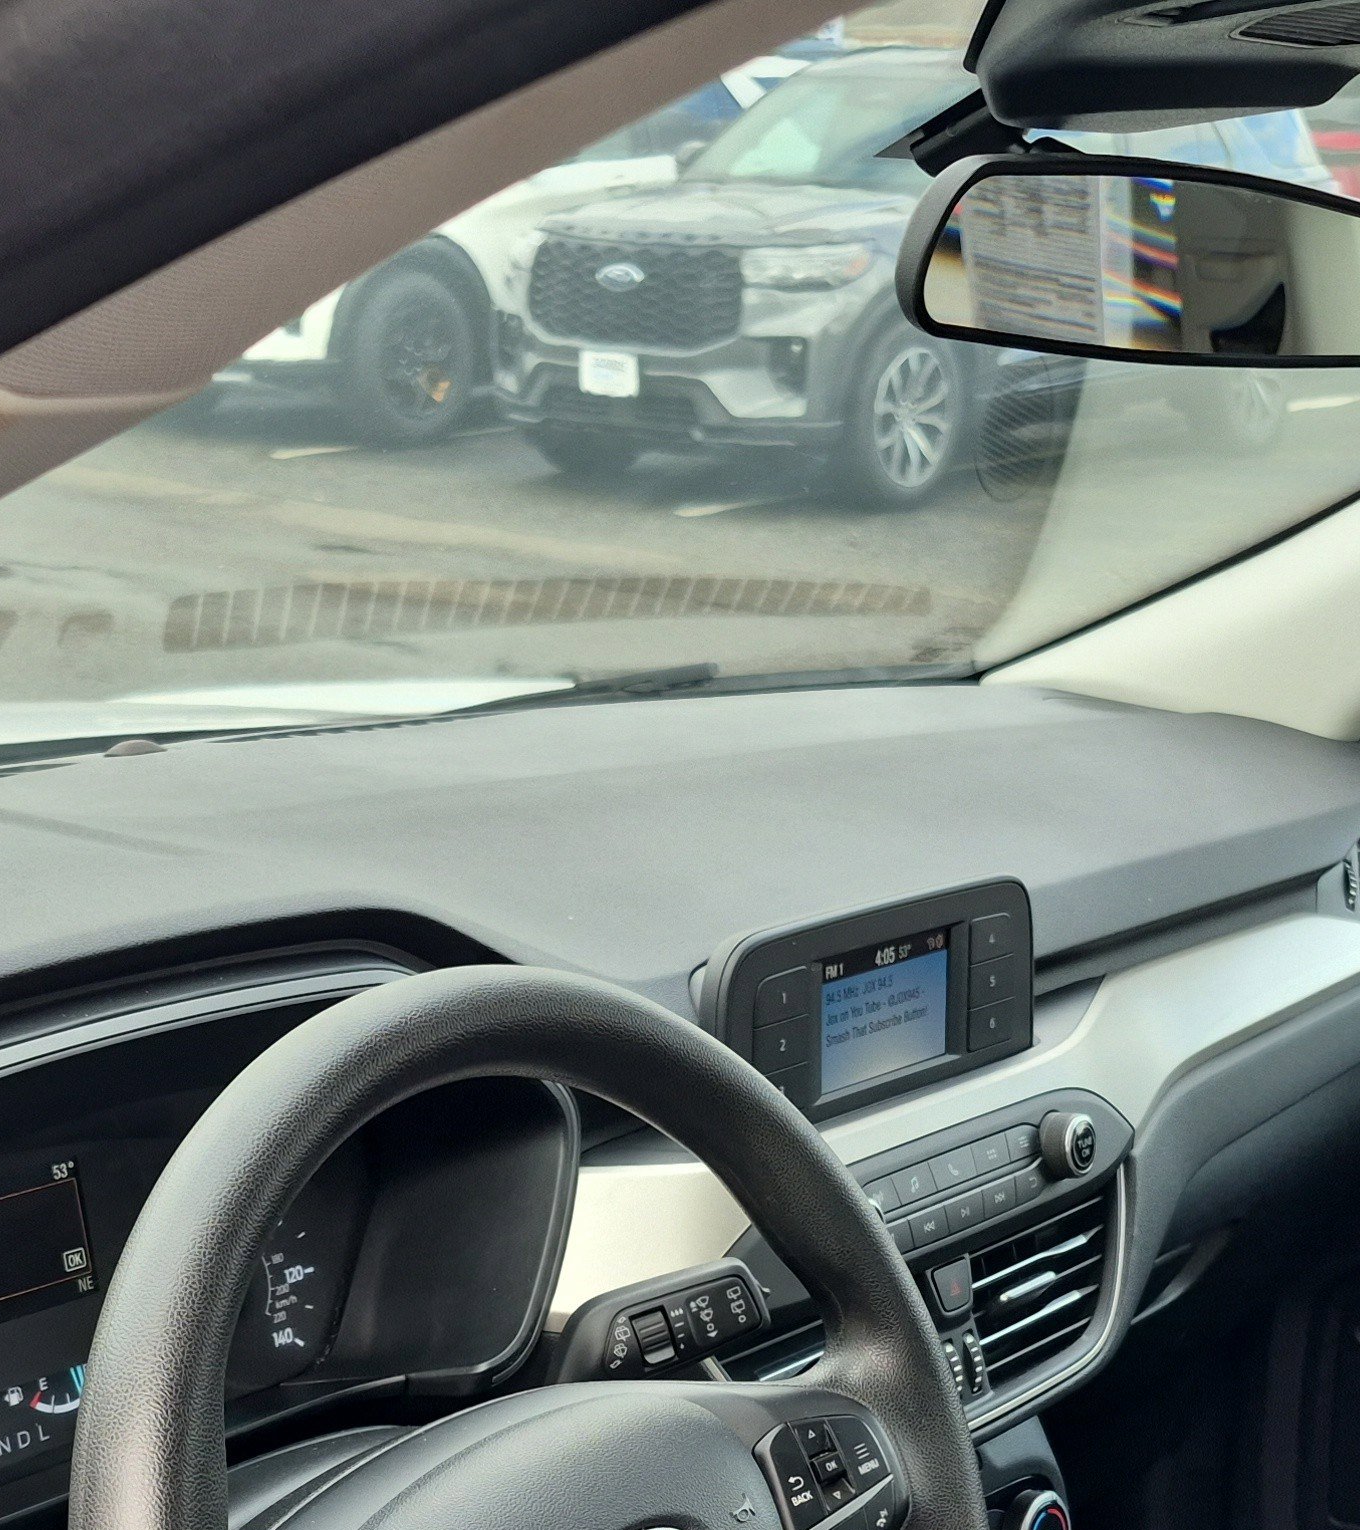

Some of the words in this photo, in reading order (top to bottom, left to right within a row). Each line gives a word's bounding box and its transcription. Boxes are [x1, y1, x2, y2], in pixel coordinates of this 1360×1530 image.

[825, 965, 838, 980] FM
[839, 963, 844, 976] 1
[874, 947, 896, 967] 4:05
[989, 974, 996, 987] 5
[782, 992, 787, 1004] 1
[779, 1039, 786, 1052] 2
[67, 1251, 83, 1268] OK
[284, 1265, 303, 1283] 120
[77, 1275, 95, 1293] NE
[271, 1327, 293, 1348] 140
[38, 1377, 49, 1391] E
[16, 1430, 31, 1449] D
[35, 1423, 51, 1442] L
[825, 1461, 839, 1472] OK
[857, 1458, 880, 1475] MENU
[790, 1490, 814, 1507] BACK
